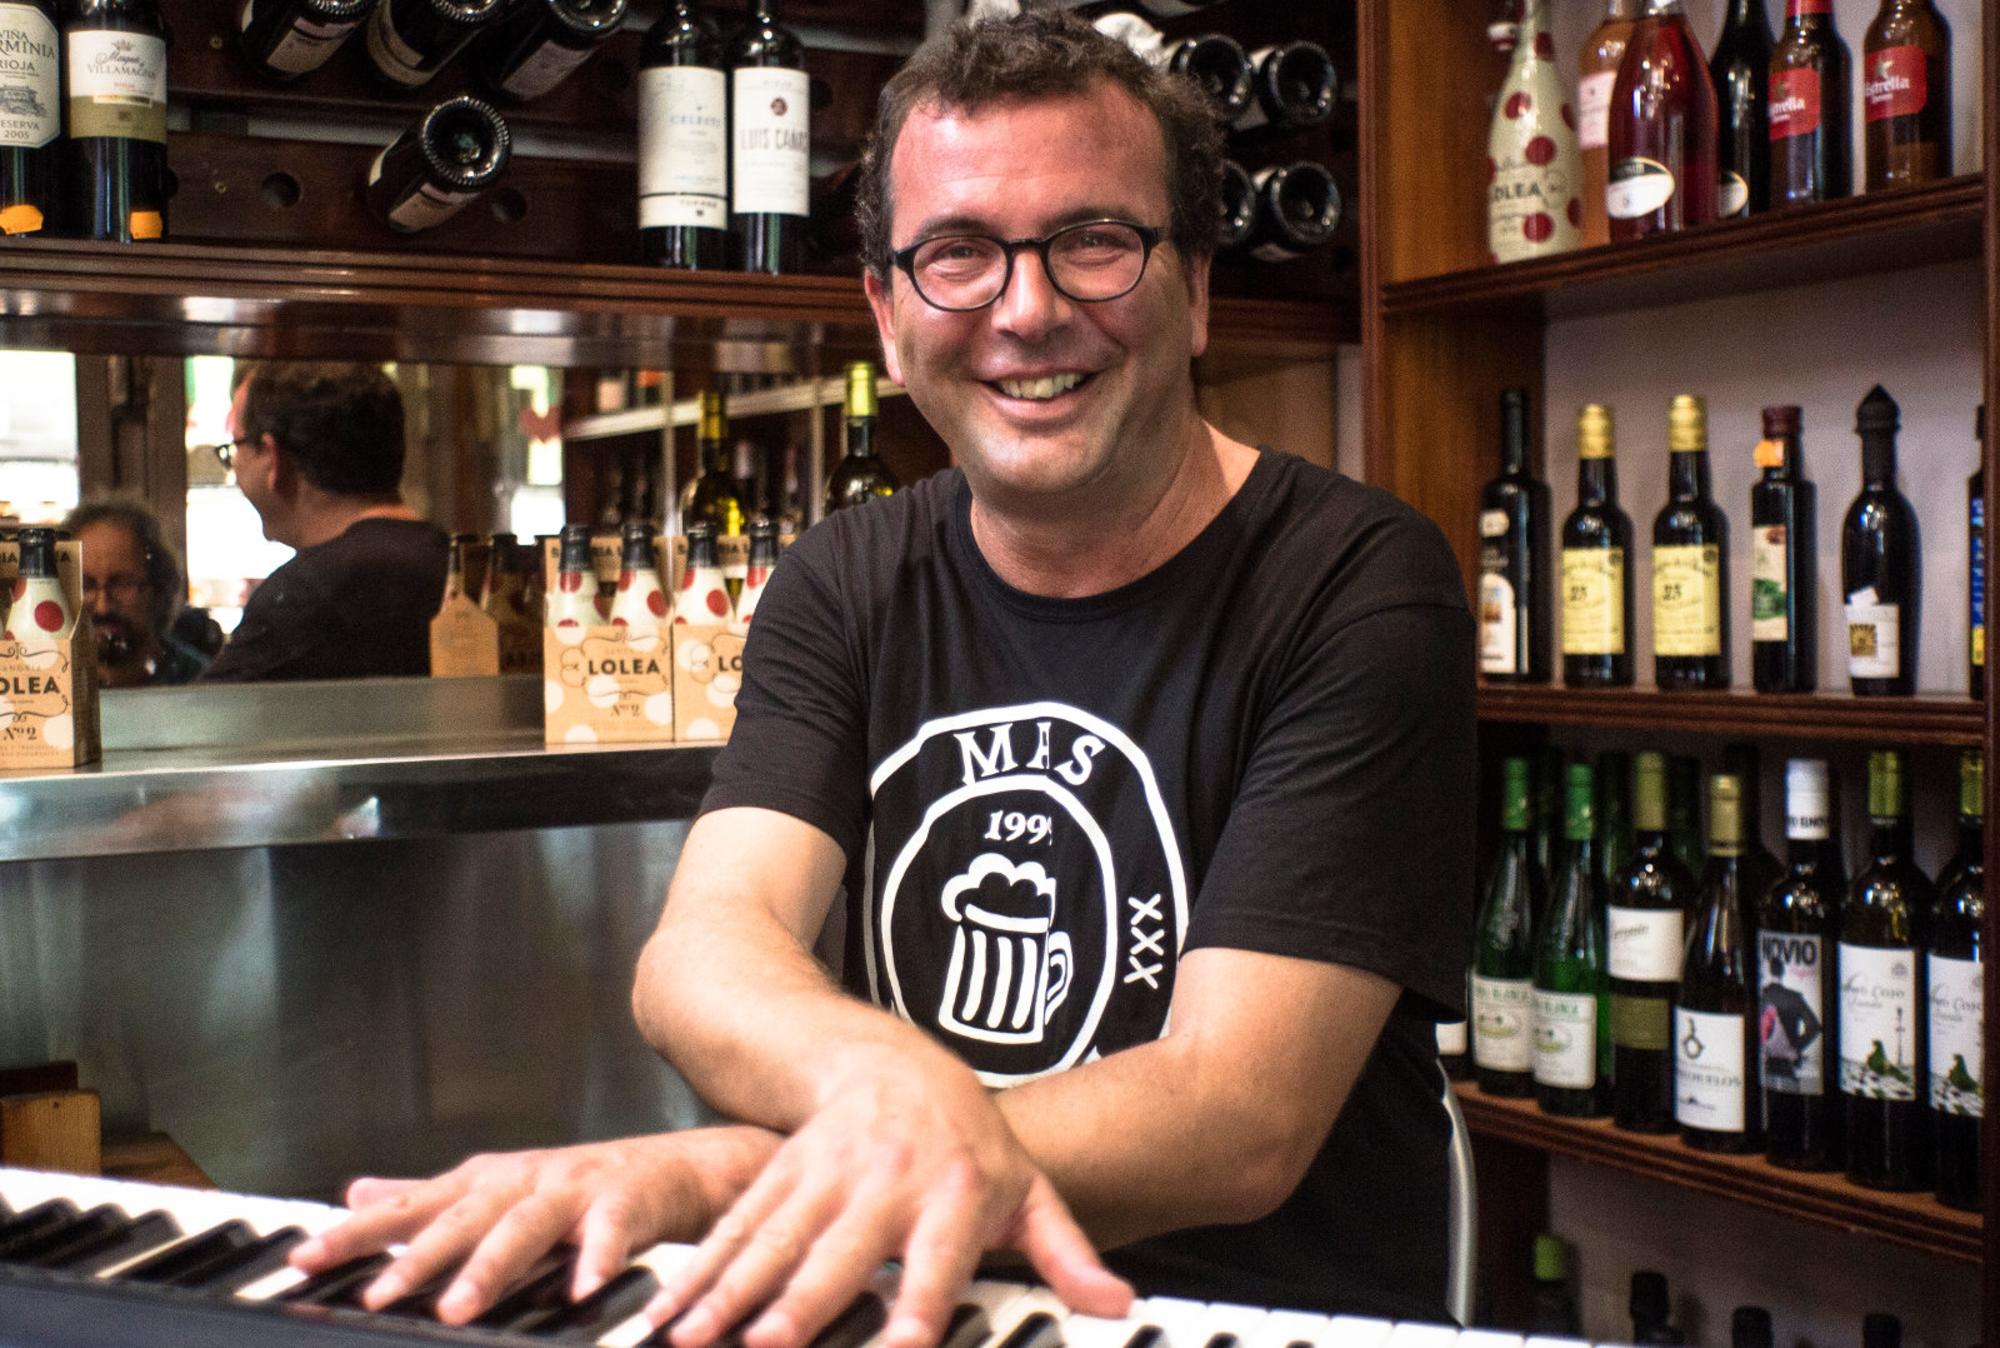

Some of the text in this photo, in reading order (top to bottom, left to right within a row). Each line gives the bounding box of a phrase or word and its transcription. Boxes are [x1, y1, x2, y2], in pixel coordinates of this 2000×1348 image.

[4, 129, 30, 139] 2005
[740, 128, 770, 150] LUIS
[588, 658, 660, 676] LOLEA
